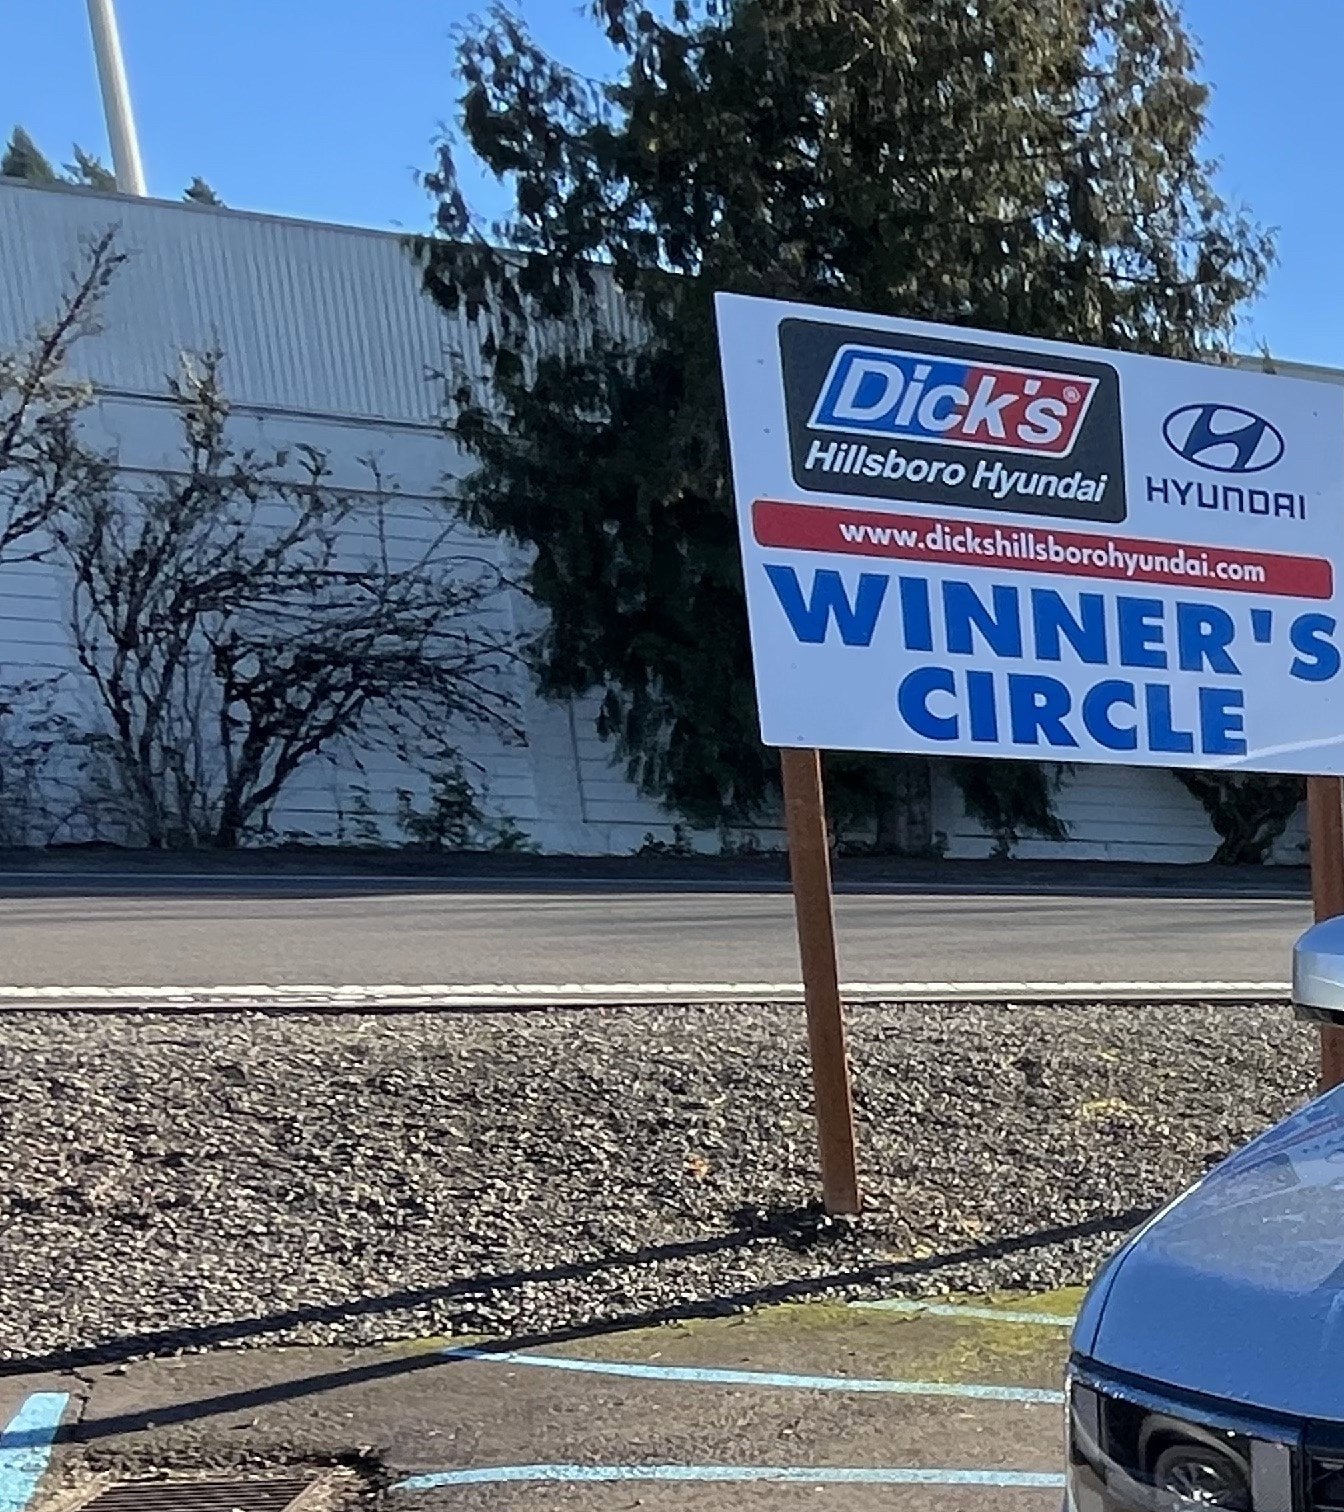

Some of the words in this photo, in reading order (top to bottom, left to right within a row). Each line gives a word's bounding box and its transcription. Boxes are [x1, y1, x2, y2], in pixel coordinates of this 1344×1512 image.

[830, 356, 1070, 445] Dick's
[804, 441, 966, 486] Hillsboro
[972, 461, 1107, 503] Hyundai
[1145, 476, 1307, 520] HYUNDAI
[838, 519, 1266, 583] www.dickshillsborohyundai.com
[762, 563, 1342, 682] WINNER'S
[897, 666, 1248, 757] CIRCLE
